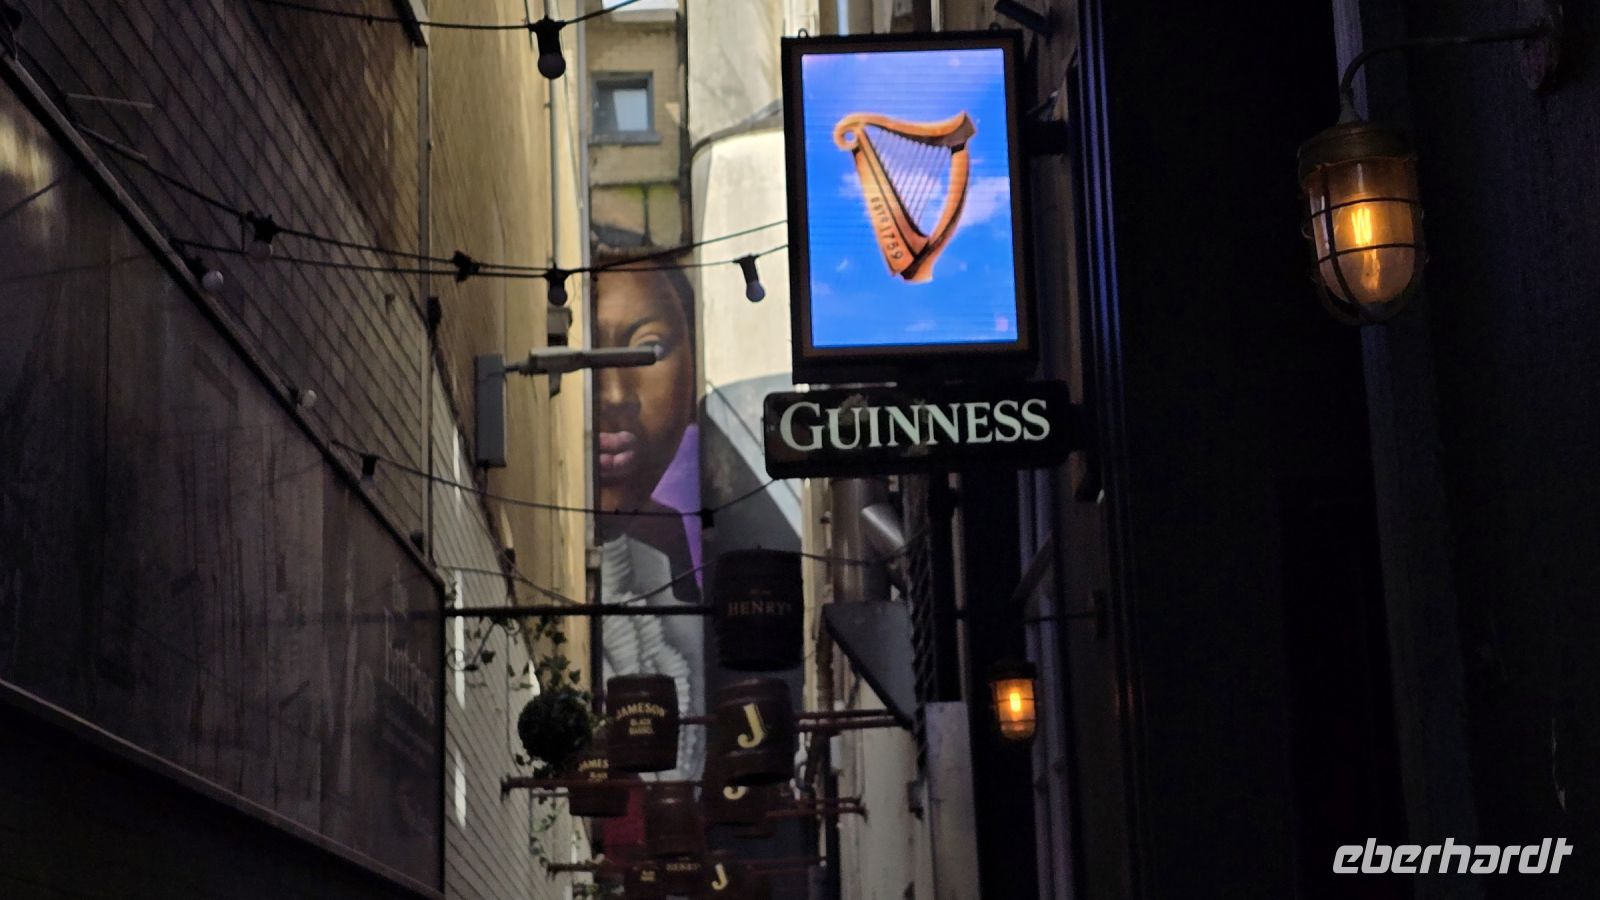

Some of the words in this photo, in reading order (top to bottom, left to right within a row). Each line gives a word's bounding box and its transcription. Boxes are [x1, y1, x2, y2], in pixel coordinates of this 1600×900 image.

[879, 226, 904, 260] 1759
[779, 398, 1050, 451] GUINNESS
[616, 702, 665, 719] JAMESON
[737, 703, 766, 748] J
[712, 863, 728, 890] J
